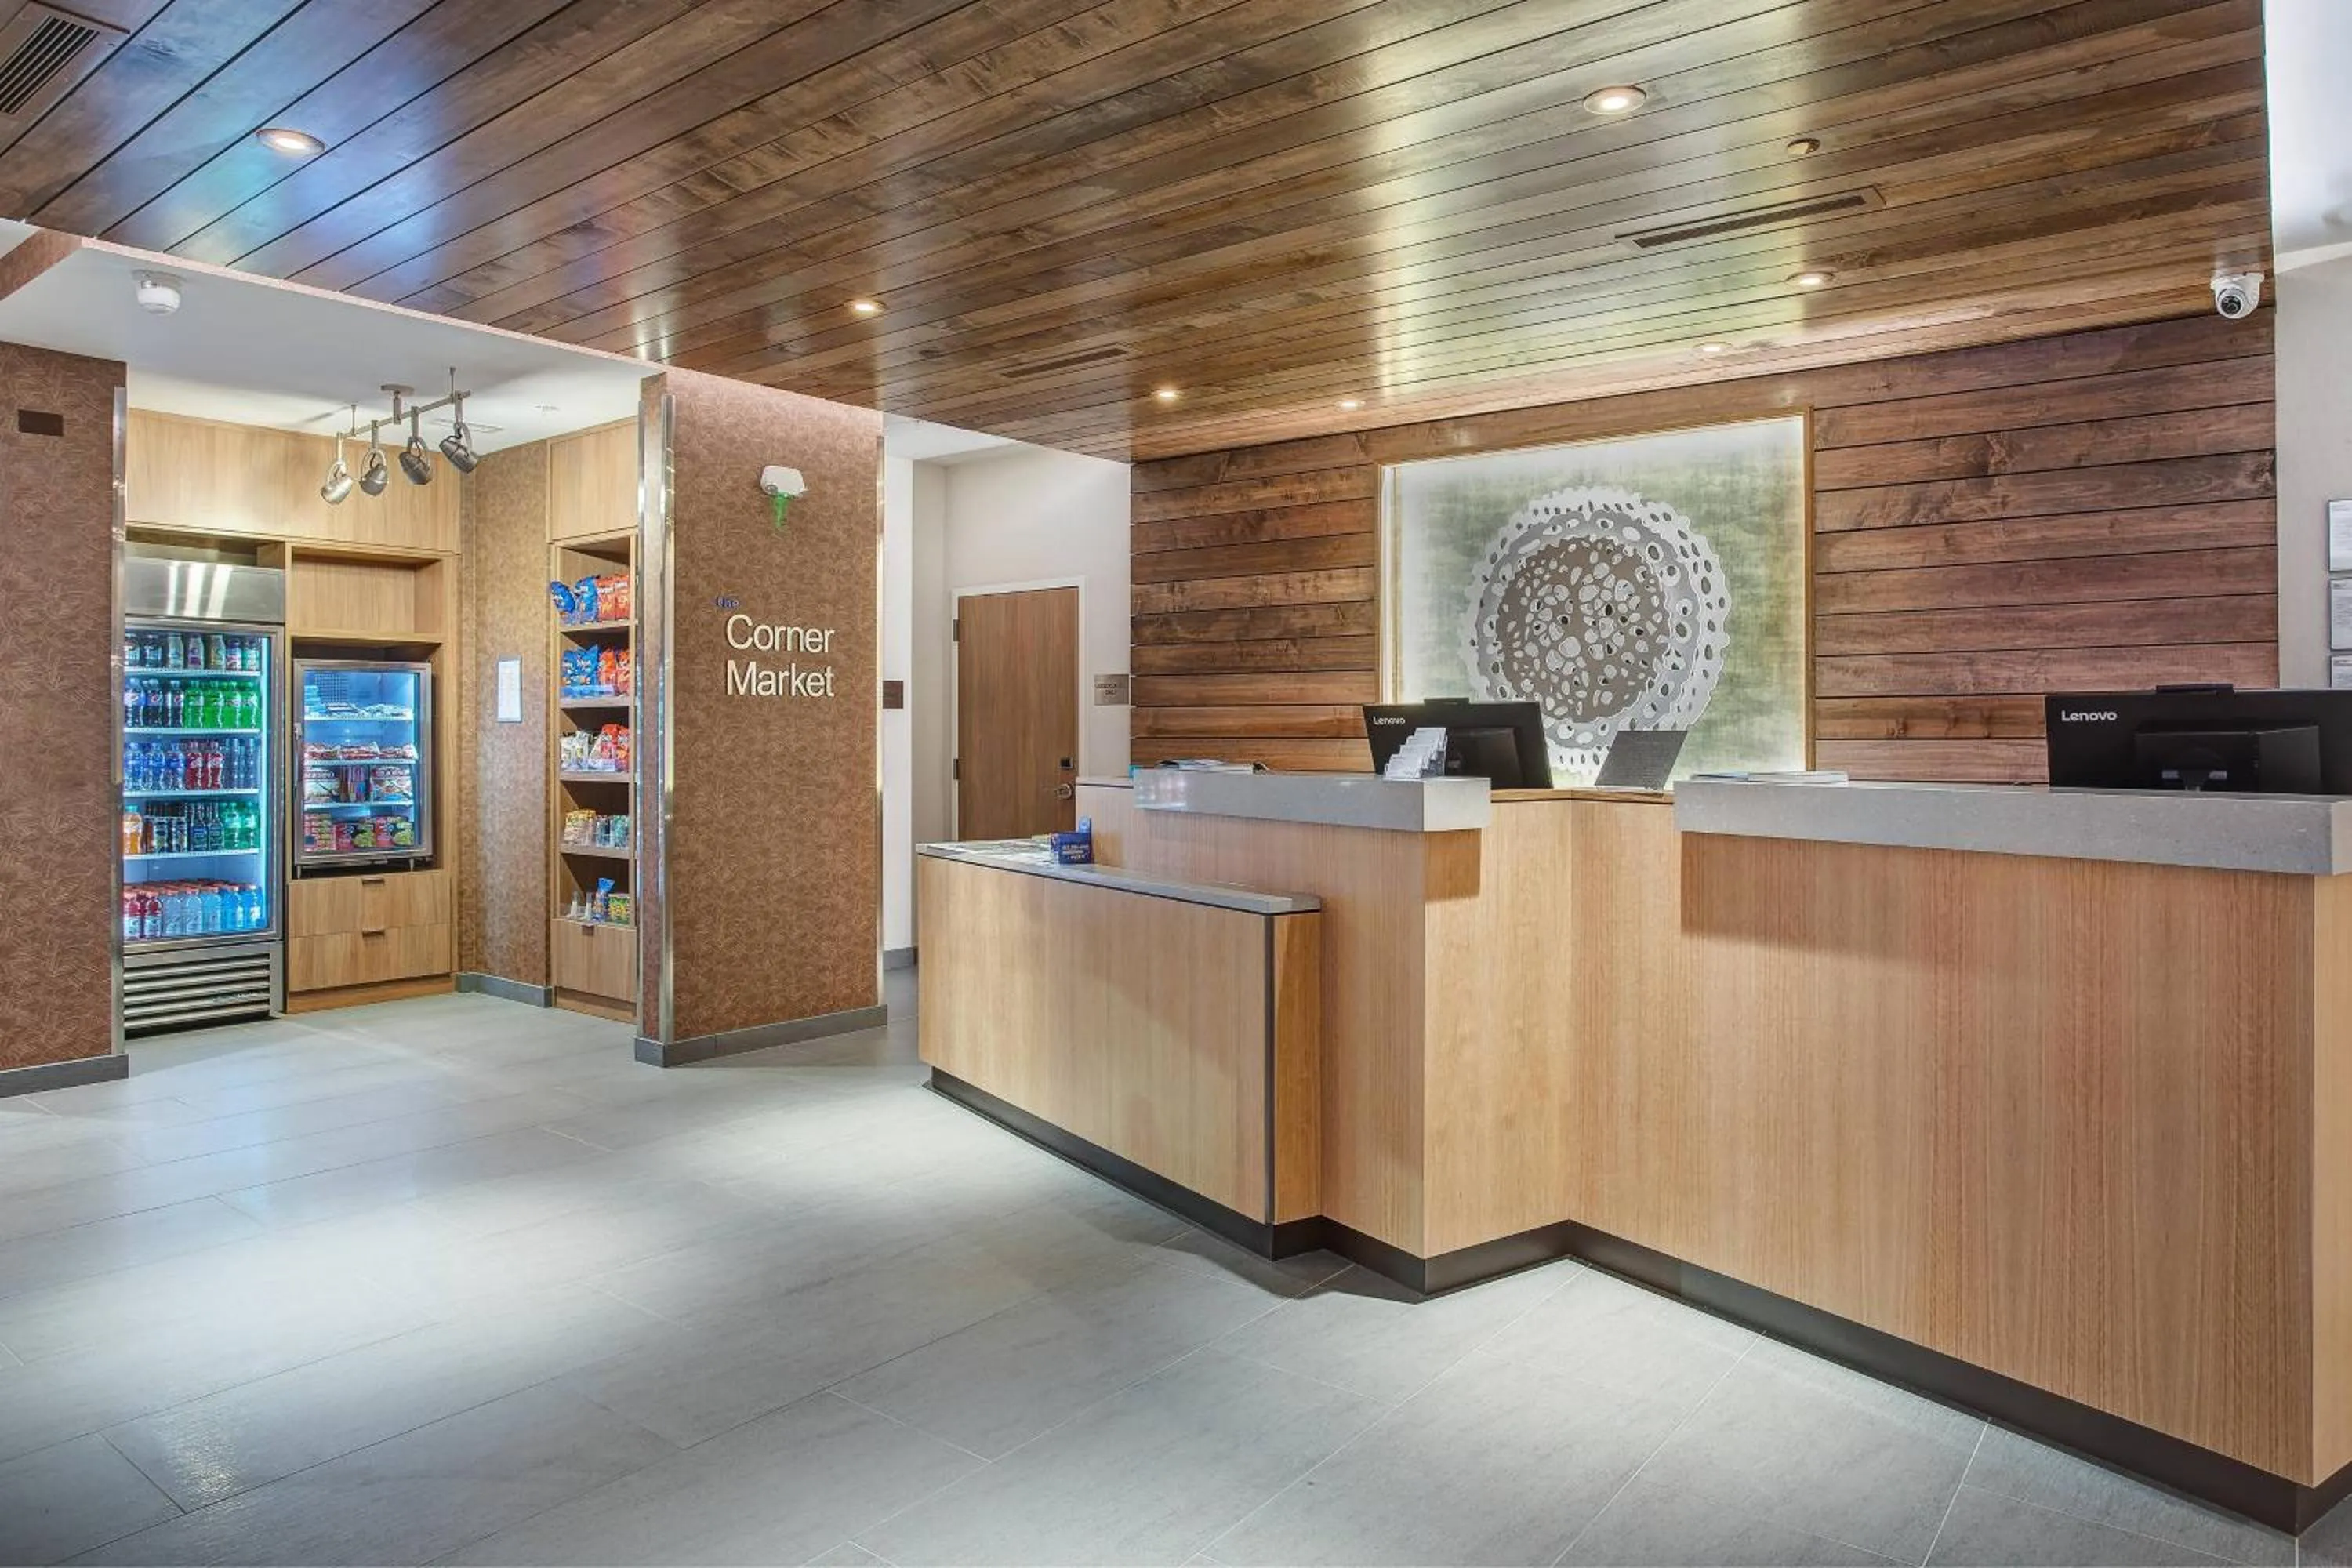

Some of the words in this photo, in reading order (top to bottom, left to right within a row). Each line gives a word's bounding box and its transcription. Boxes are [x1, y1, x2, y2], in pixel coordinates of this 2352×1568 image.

[726, 614, 835, 653] Corner
[726, 659, 835, 697] Market
[1373, 716, 1406, 725] Lenovo
[2061, 710, 2118, 721] Lenovo
